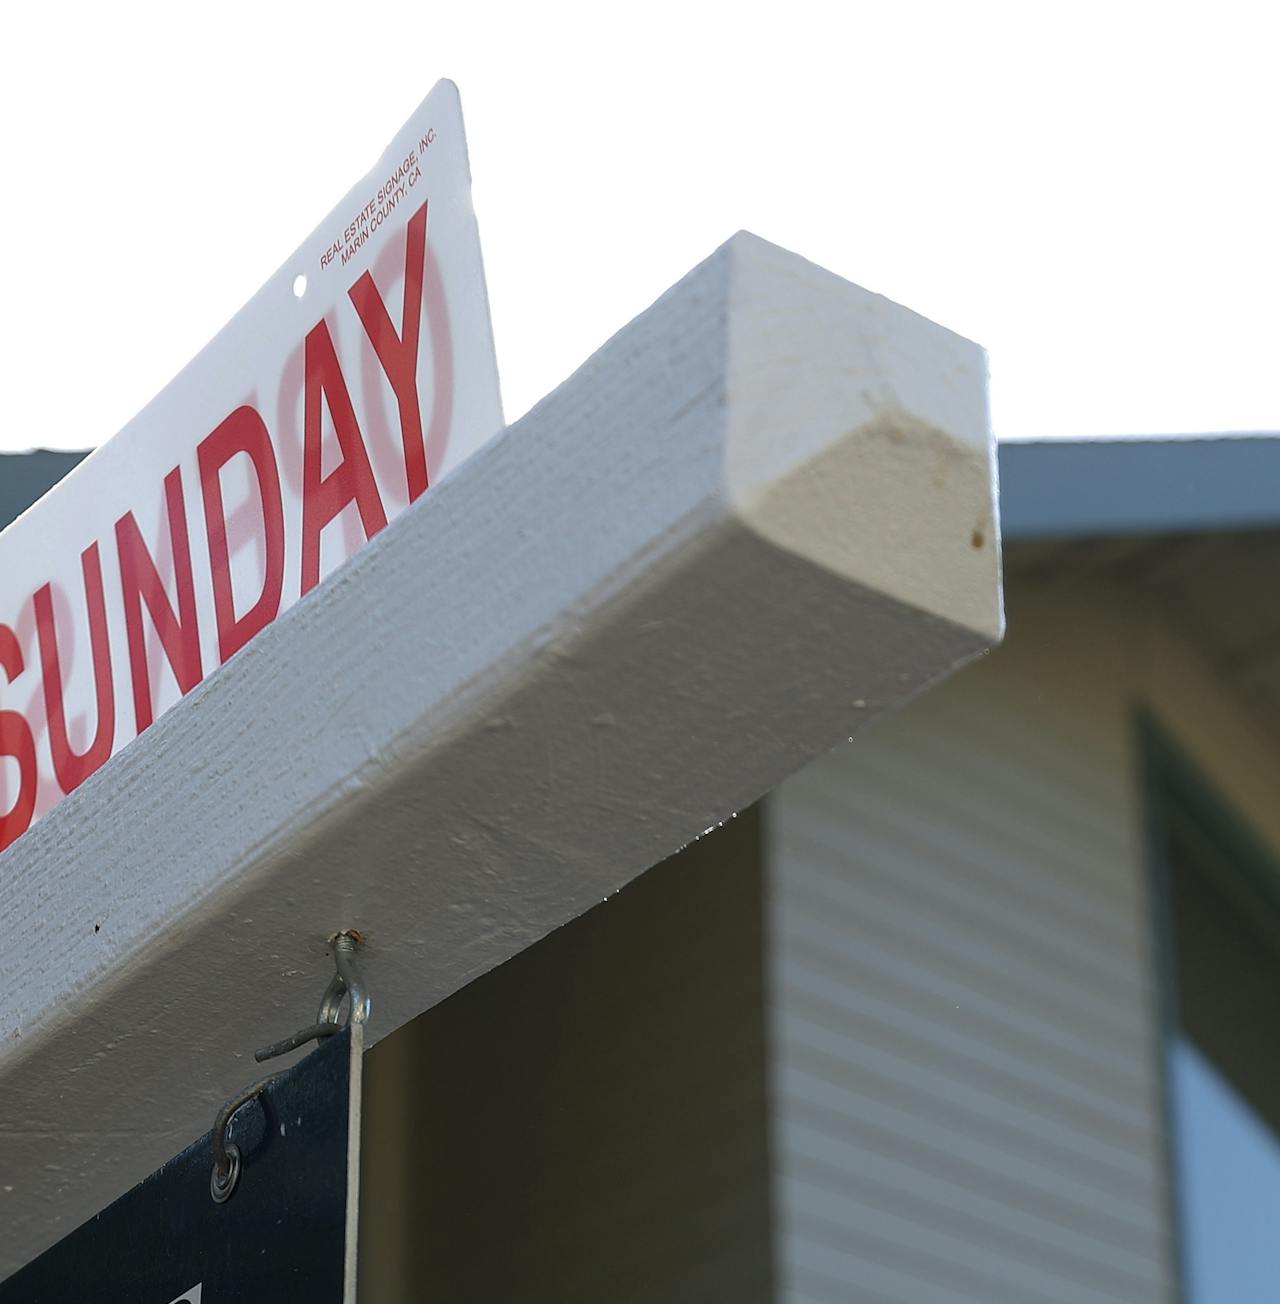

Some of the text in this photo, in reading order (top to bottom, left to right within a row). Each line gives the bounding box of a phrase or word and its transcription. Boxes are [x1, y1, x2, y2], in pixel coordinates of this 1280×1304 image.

[321, 128, 436, 269] REAL ESTATE SIGNAGE, INC.
[341, 167, 422, 266] MARIN COUNTY, CA
